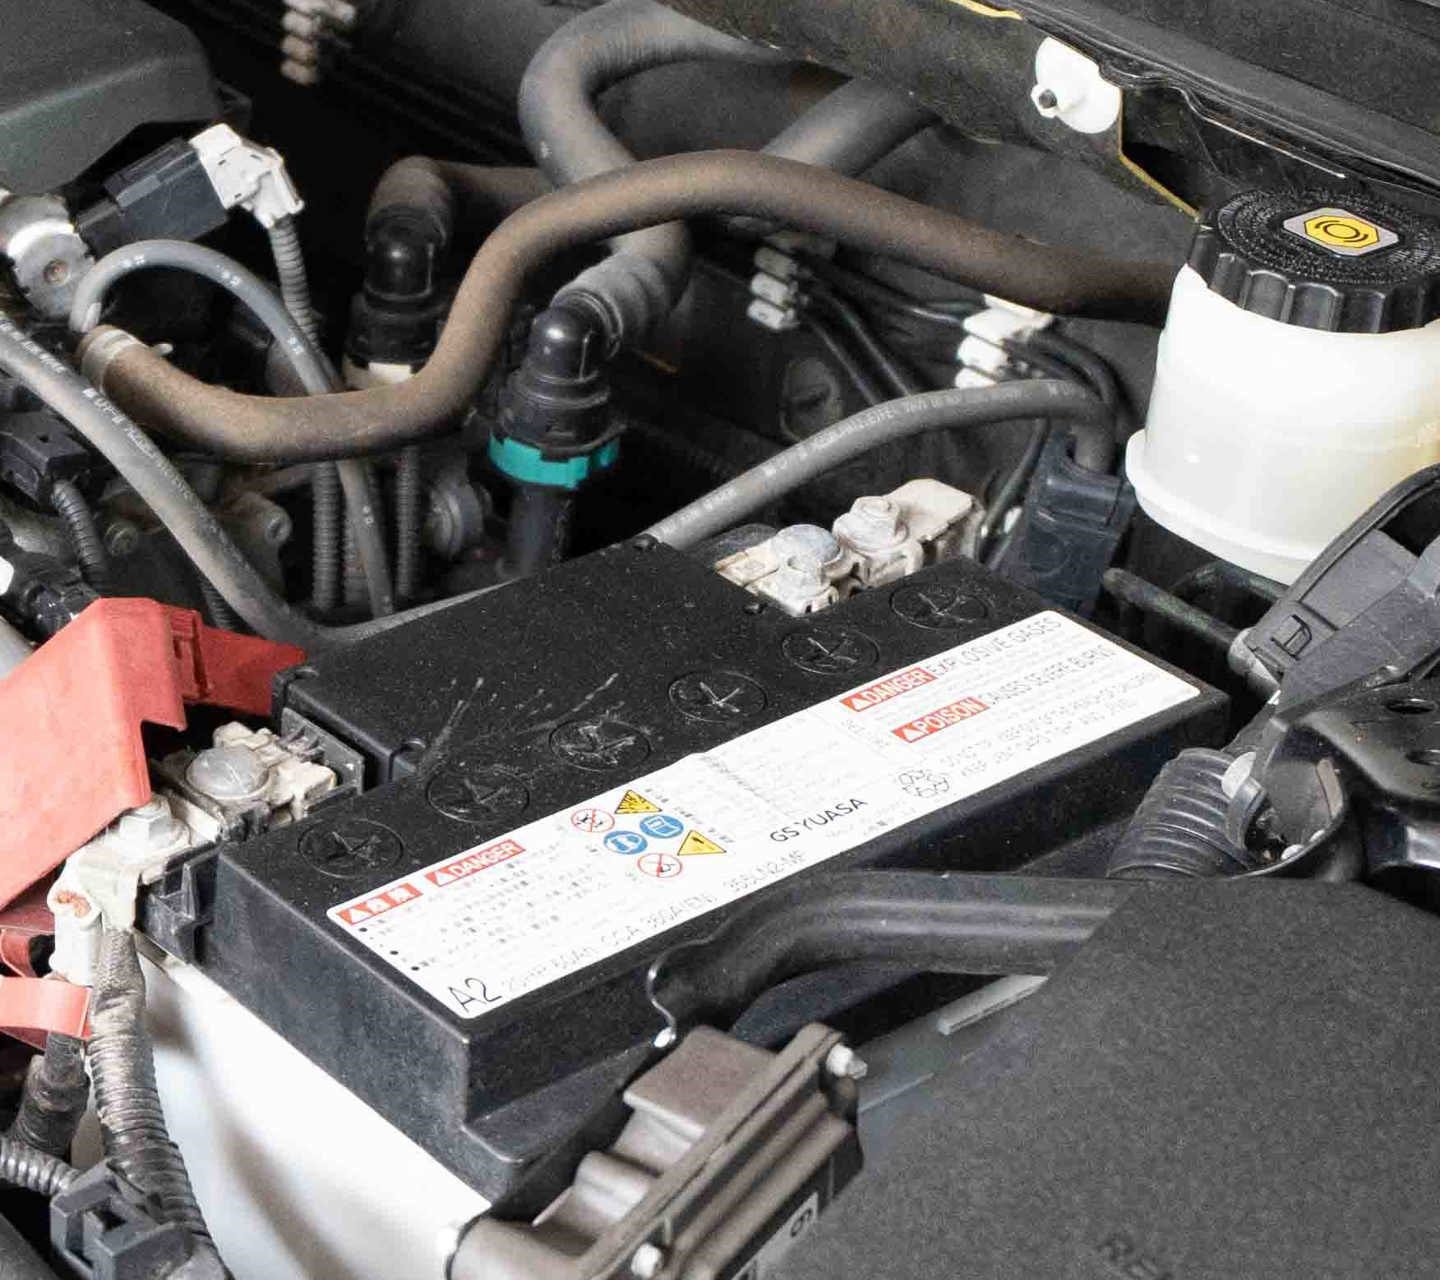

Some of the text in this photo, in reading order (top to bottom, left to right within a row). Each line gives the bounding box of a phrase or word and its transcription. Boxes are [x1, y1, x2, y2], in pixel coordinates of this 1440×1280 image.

[862, 669, 934, 703] DANGER
[1007, 616, 1062, 643] GASES
[913, 698, 984, 734] POISON
[768, 825, 801, 844] GS
[797, 796, 868, 831] YUASA
[451, 841, 520, 877] DANGER
[447, 977, 503, 1013] A2
